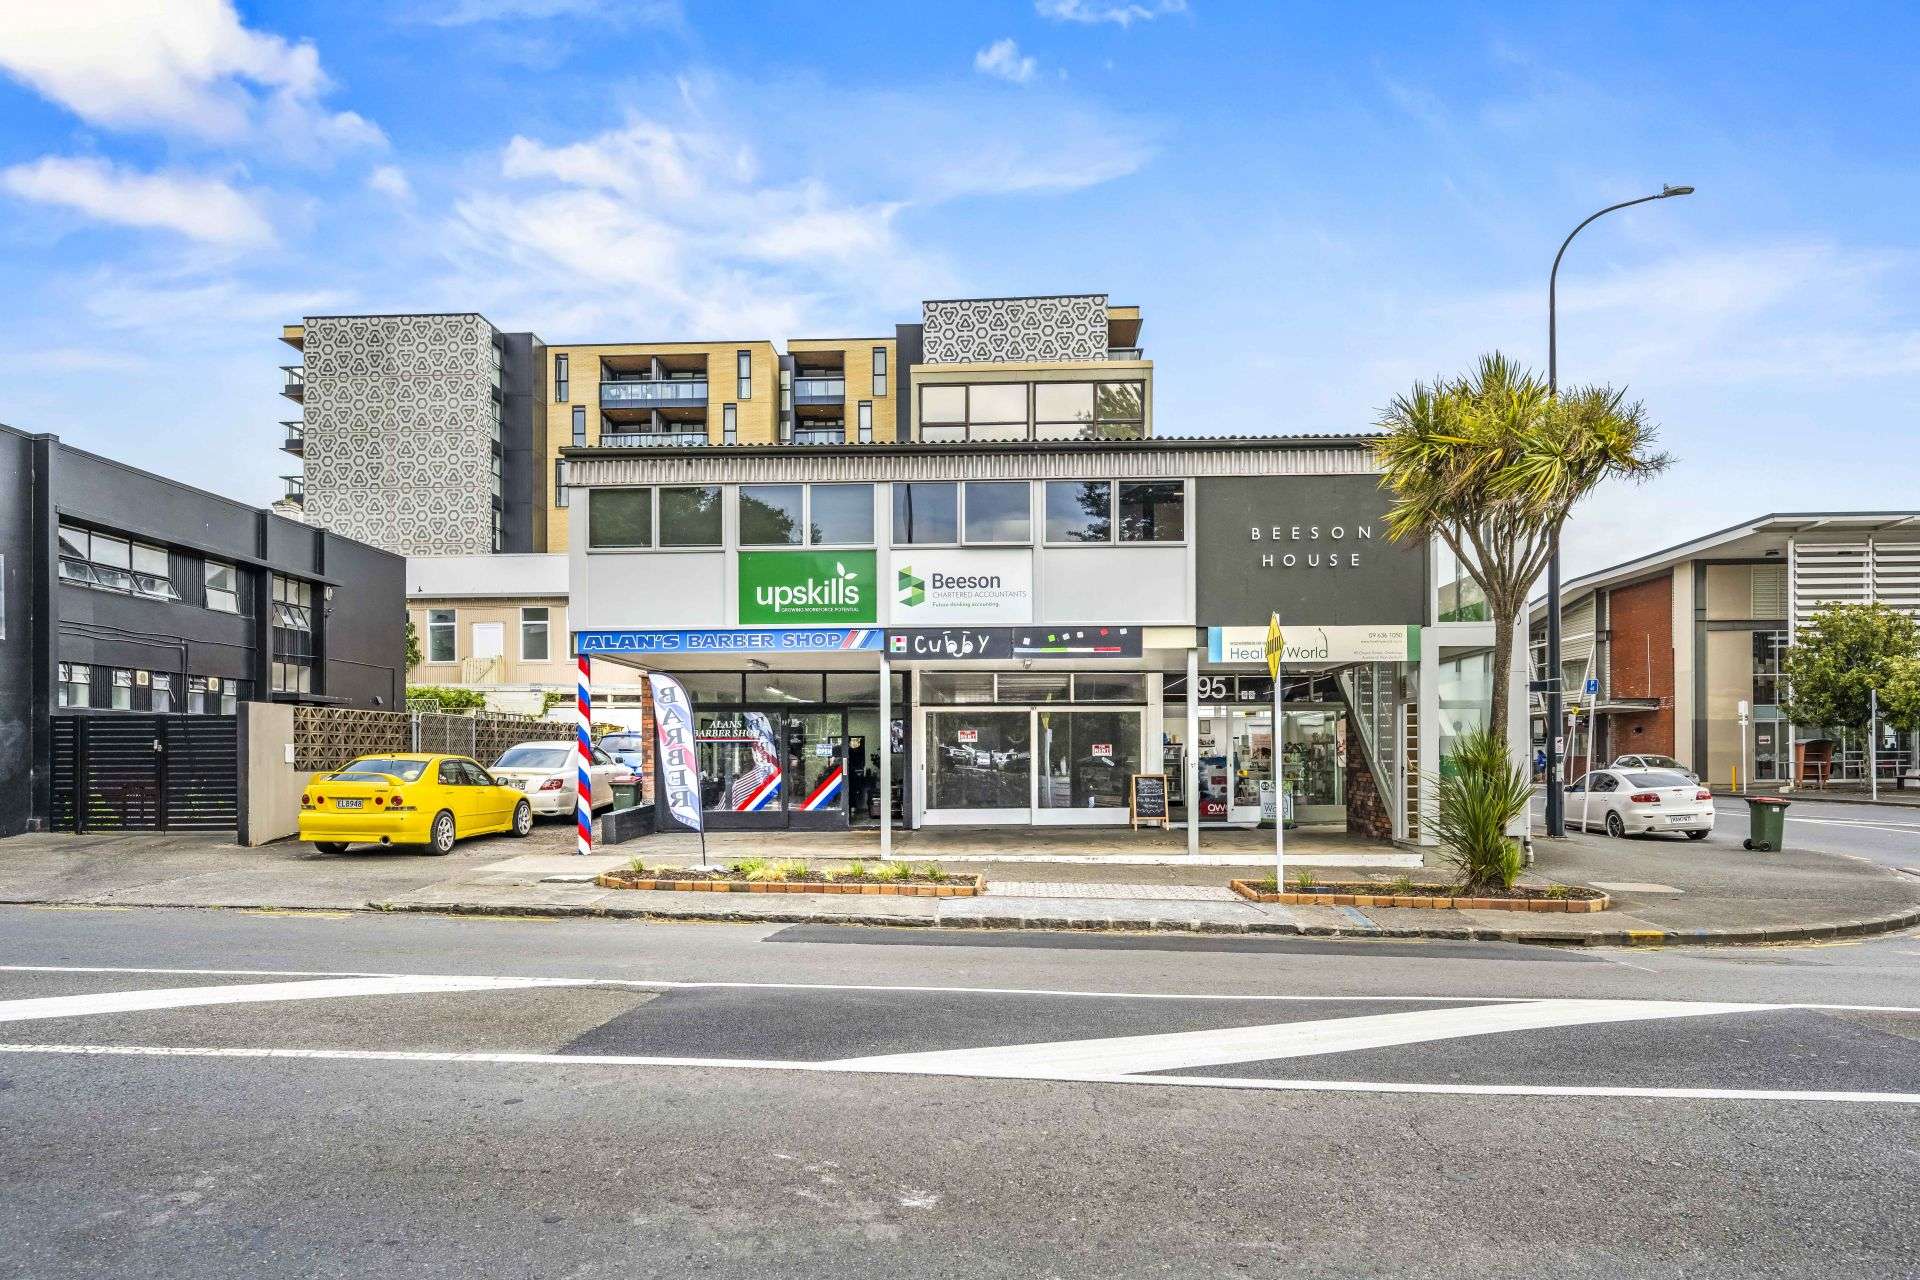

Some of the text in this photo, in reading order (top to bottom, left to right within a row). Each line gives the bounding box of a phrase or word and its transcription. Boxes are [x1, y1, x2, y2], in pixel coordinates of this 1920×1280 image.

[1251, 526, 1371, 540] BEESON
[1262, 553, 1360, 567] HOUSE
[932, 573, 1001, 589] Beeson
[756, 578, 860, 612] upskills
[584, 632, 842, 649] ALAN'S BARBER SHOP
[1198, 677, 1226, 699] 95
